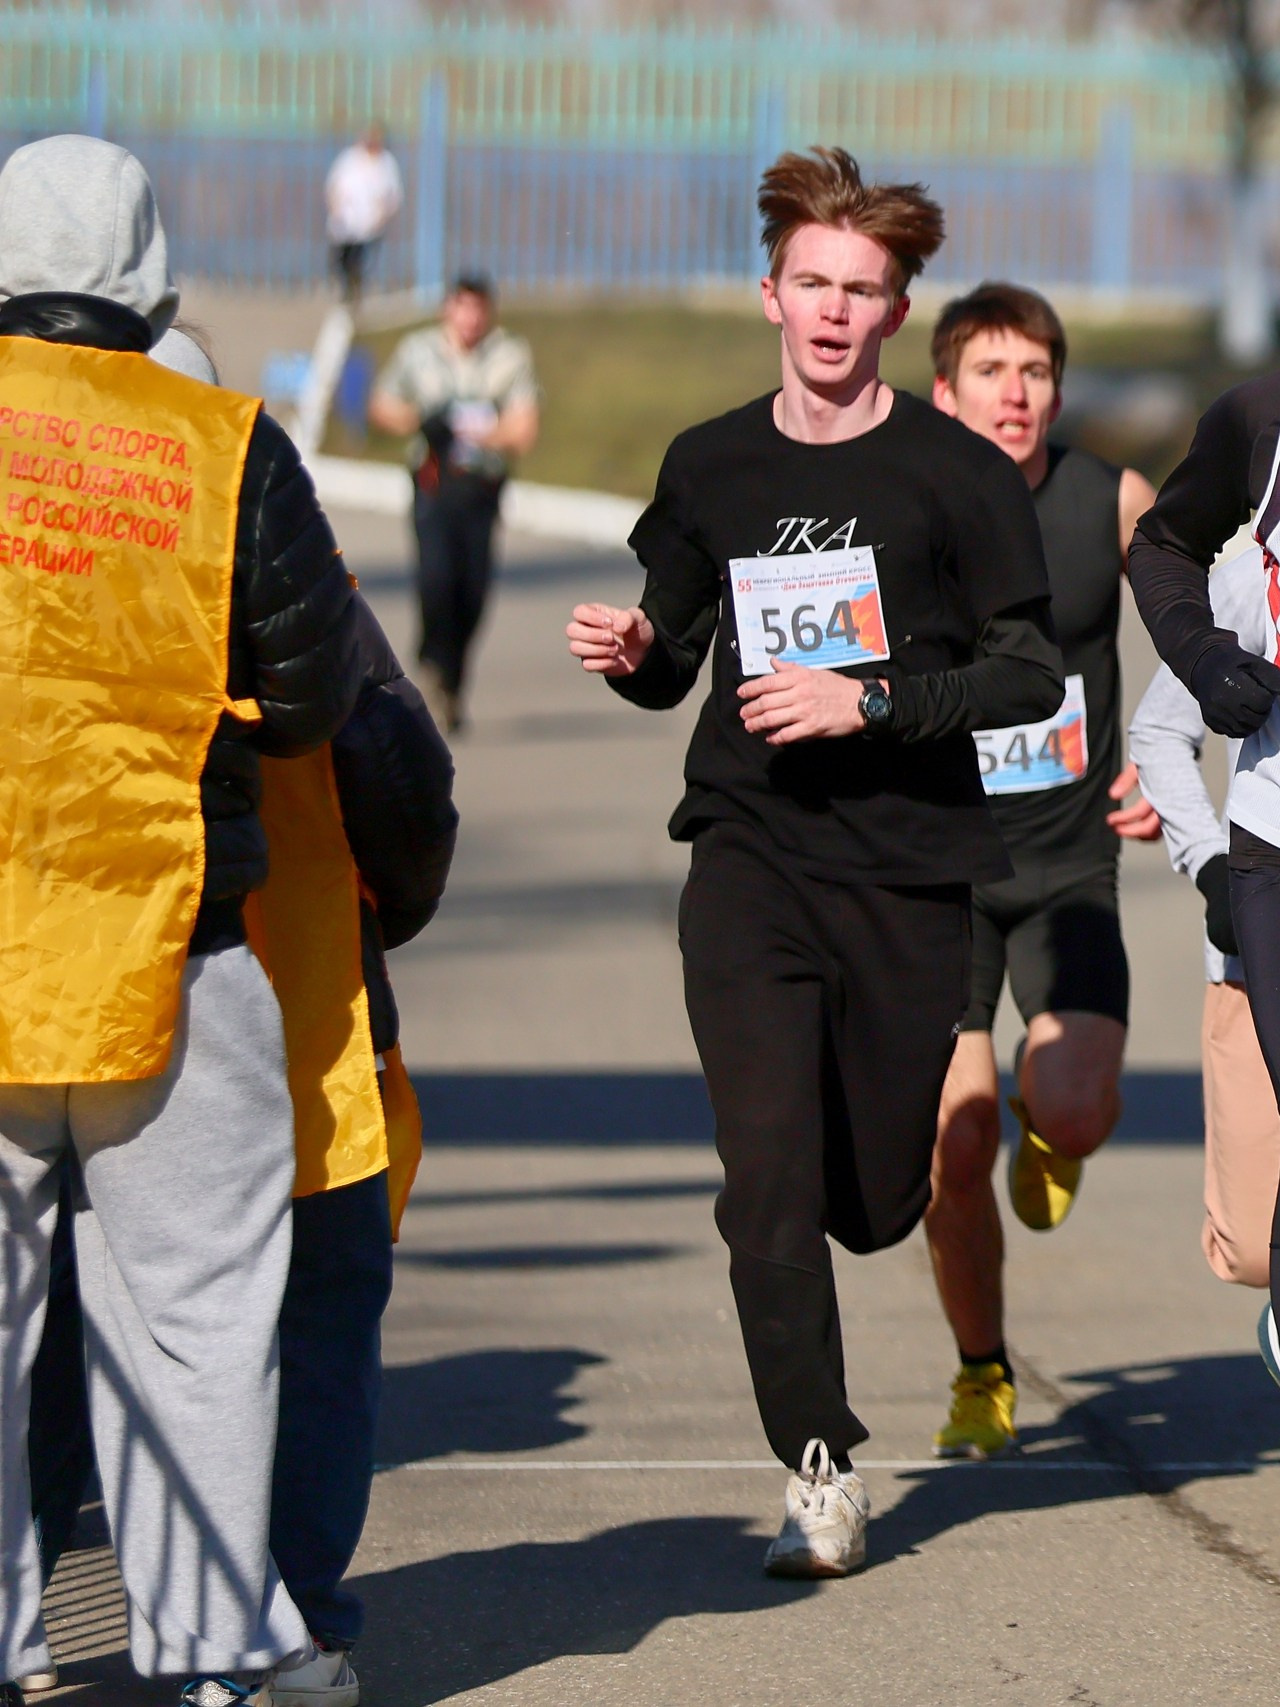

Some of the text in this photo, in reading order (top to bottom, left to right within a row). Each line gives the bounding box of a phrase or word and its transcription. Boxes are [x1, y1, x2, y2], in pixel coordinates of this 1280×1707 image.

[88, 423, 193, 475] СПОРТА,
[9, 451, 194, 513] МОЛОДЕЖНОЙ
[5, 493, 180, 553] РОССИЙСКОЙ
[738, 578, 752, 593] 55
[760, 600, 860, 655] 564
[974, 729, 1066, 775] 544
